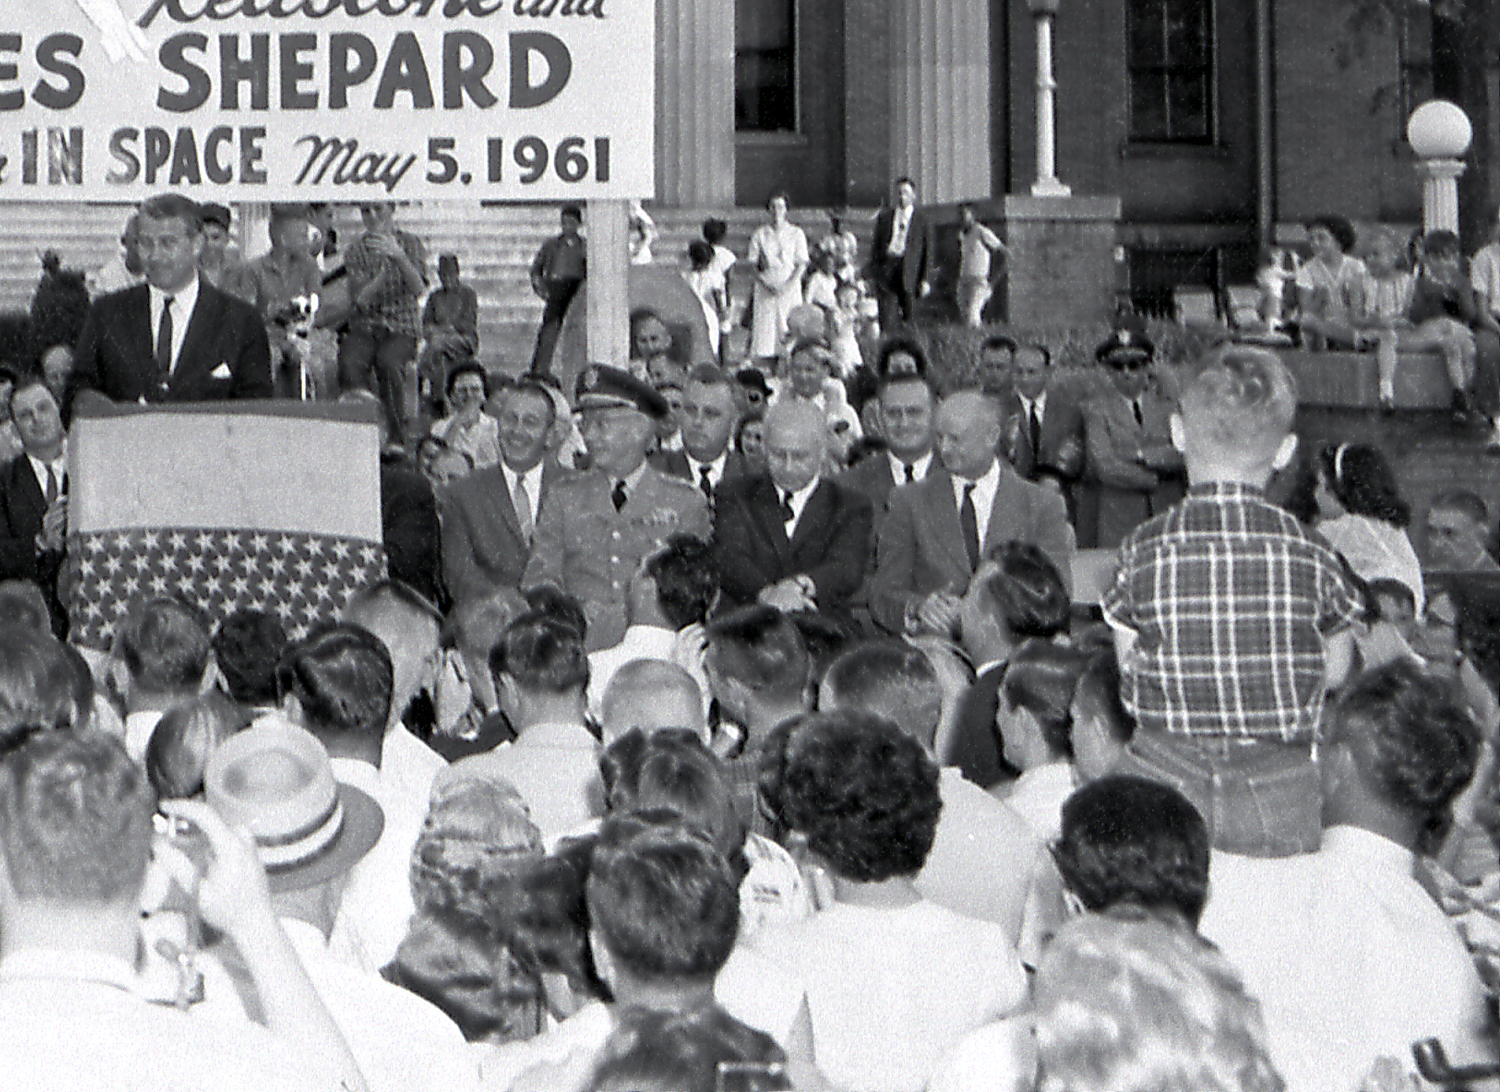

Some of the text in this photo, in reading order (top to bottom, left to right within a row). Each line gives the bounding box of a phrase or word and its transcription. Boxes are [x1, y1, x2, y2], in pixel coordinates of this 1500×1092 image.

[156, 29, 573, 114] SHEPARD
[21, 126, 84, 186] IN
[105, 125, 268, 186] SPACE
[294, 135, 417, 194] May
